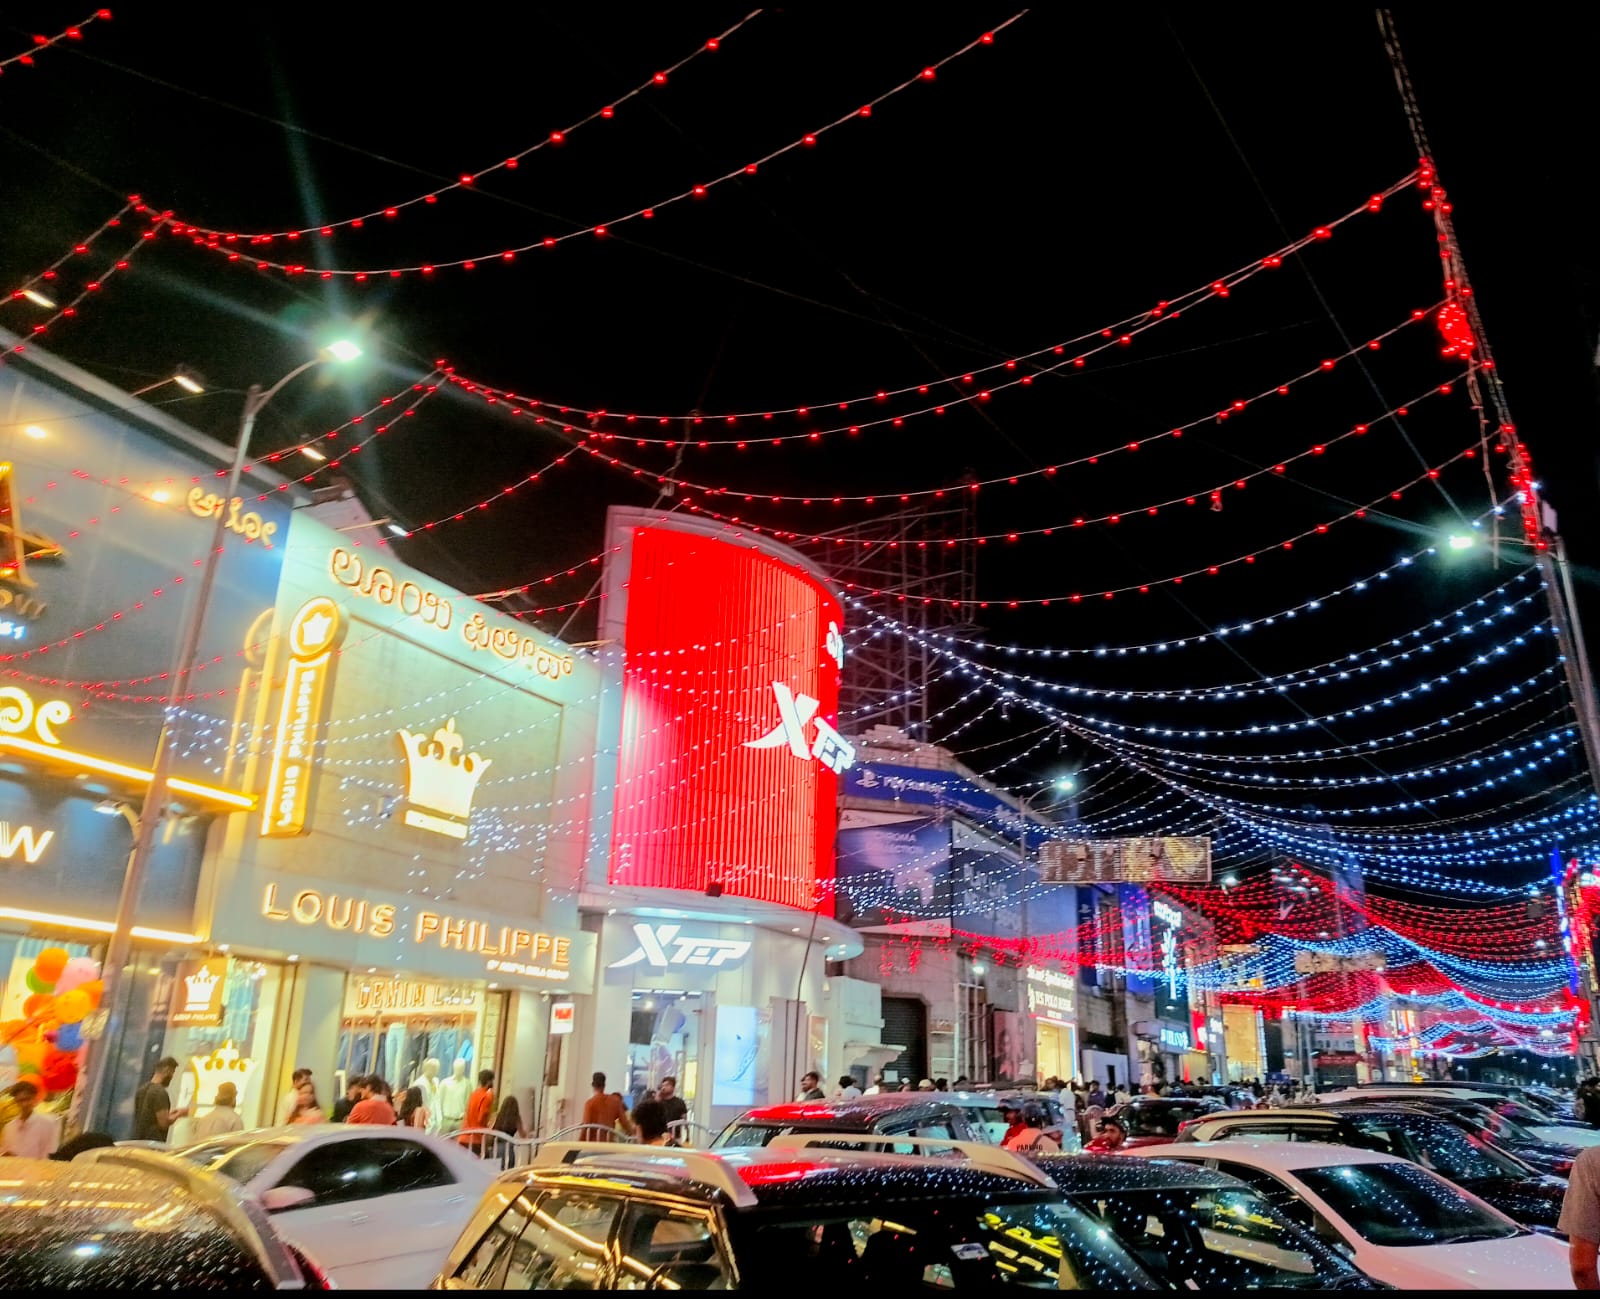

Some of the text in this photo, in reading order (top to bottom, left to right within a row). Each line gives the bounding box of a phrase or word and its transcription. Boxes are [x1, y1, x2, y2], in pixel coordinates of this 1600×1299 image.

[277, 668, 316, 827] LOUIS PHILIPPE
[741, 680, 856, 774] XTEP
[261, 882, 572, 968] LOUIS PHILIPPE
[606, 923, 752, 969] XTEP
